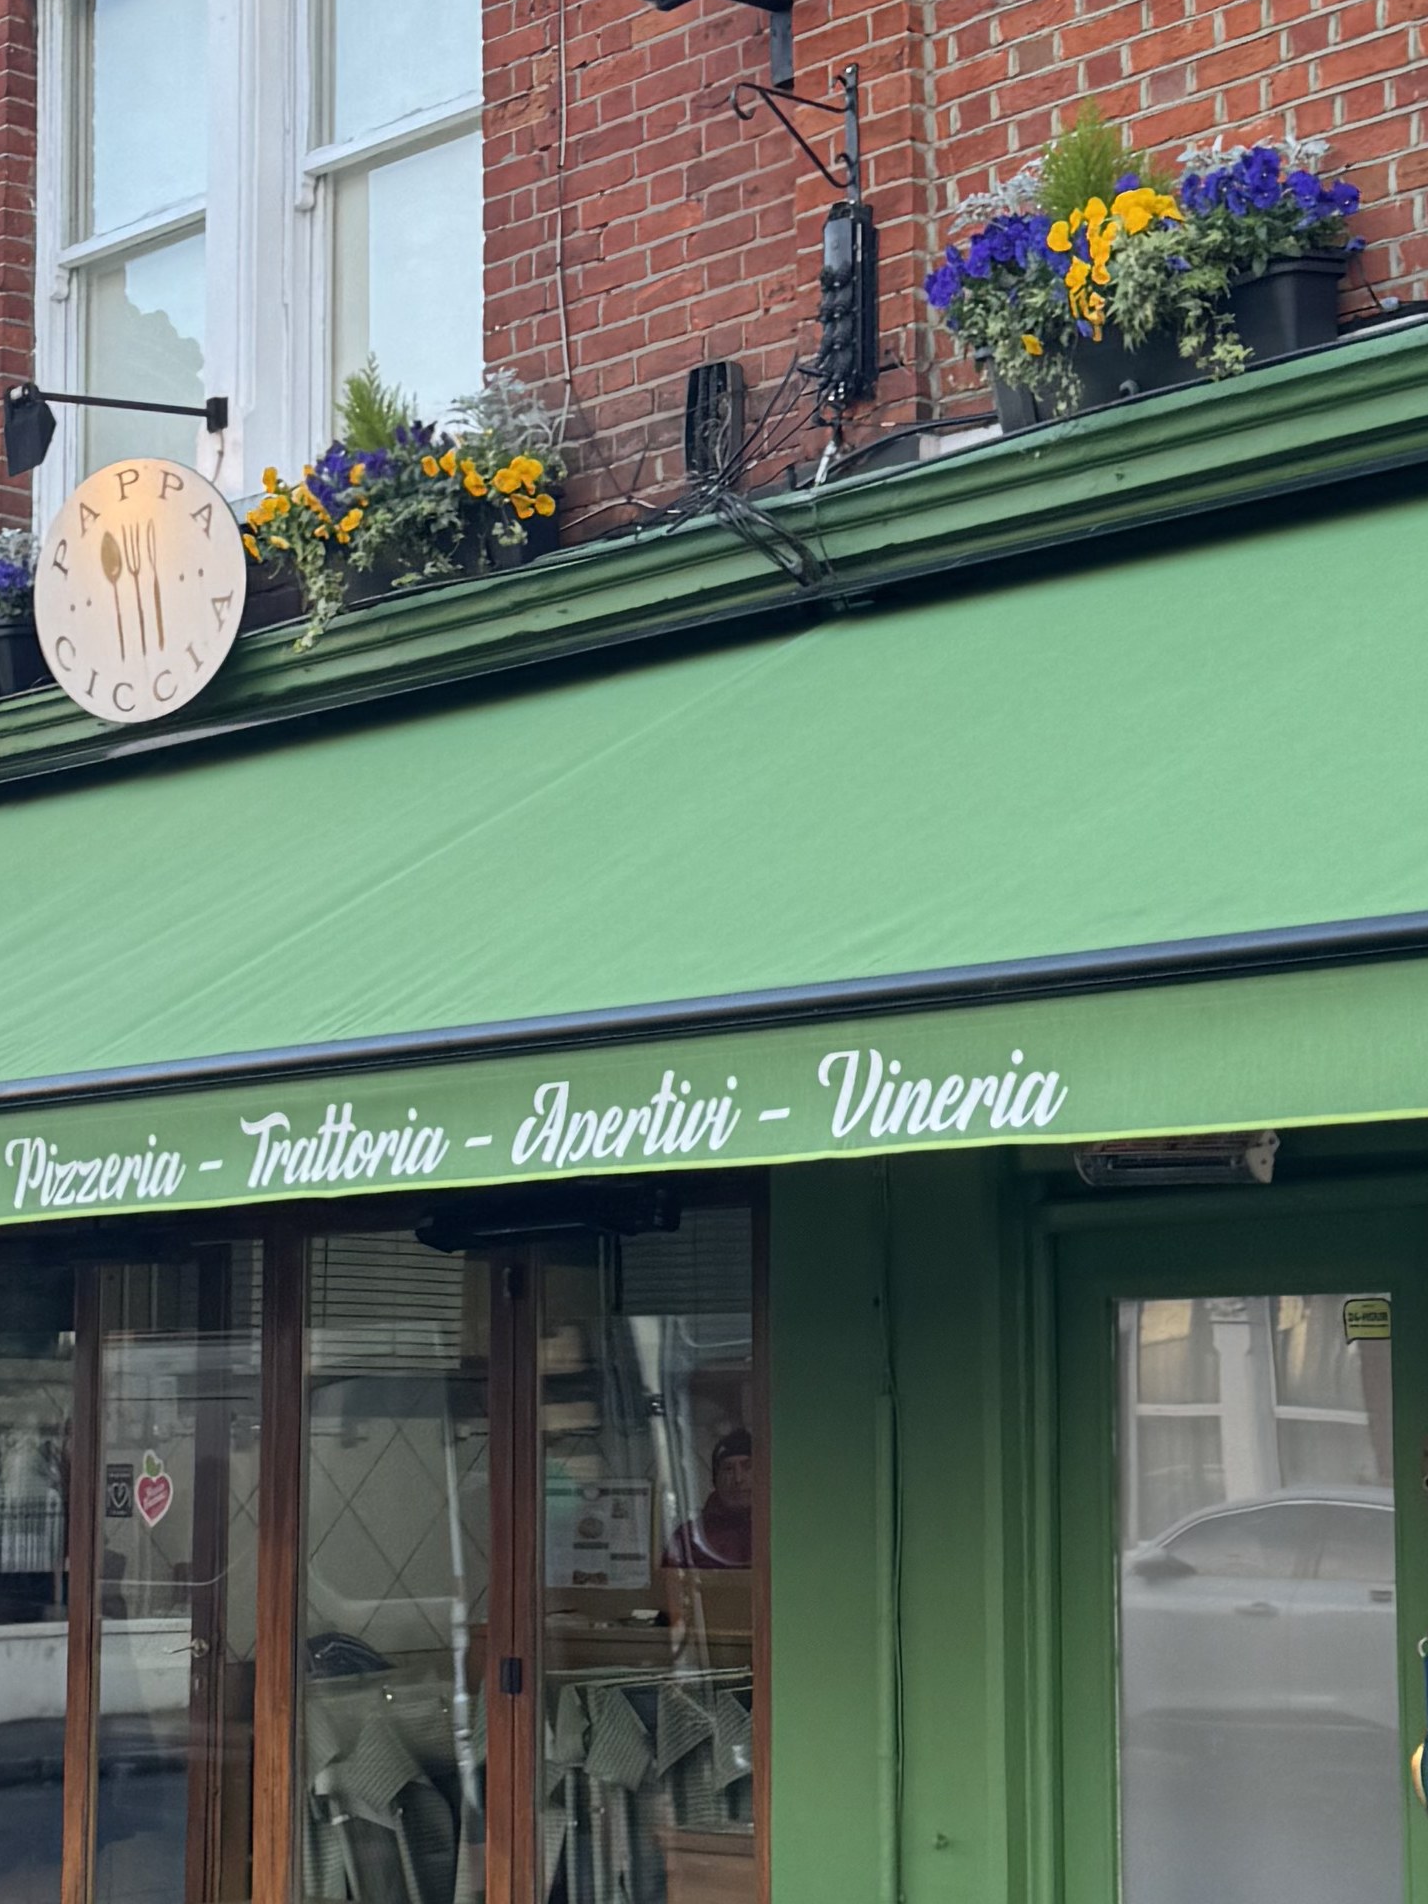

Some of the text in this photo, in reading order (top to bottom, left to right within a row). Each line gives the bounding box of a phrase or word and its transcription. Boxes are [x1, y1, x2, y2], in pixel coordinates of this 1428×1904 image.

[52, 467, 214, 582] PAPPA
[54, 588, 234, 713] CICCIA
[4, 1133, 187, 1210] Pizzeria
[239, 1101, 451, 1190] Trattoria
[510, 1069, 742, 1169] Apertivi
[817, 1048, 1069, 1138] Vineria
